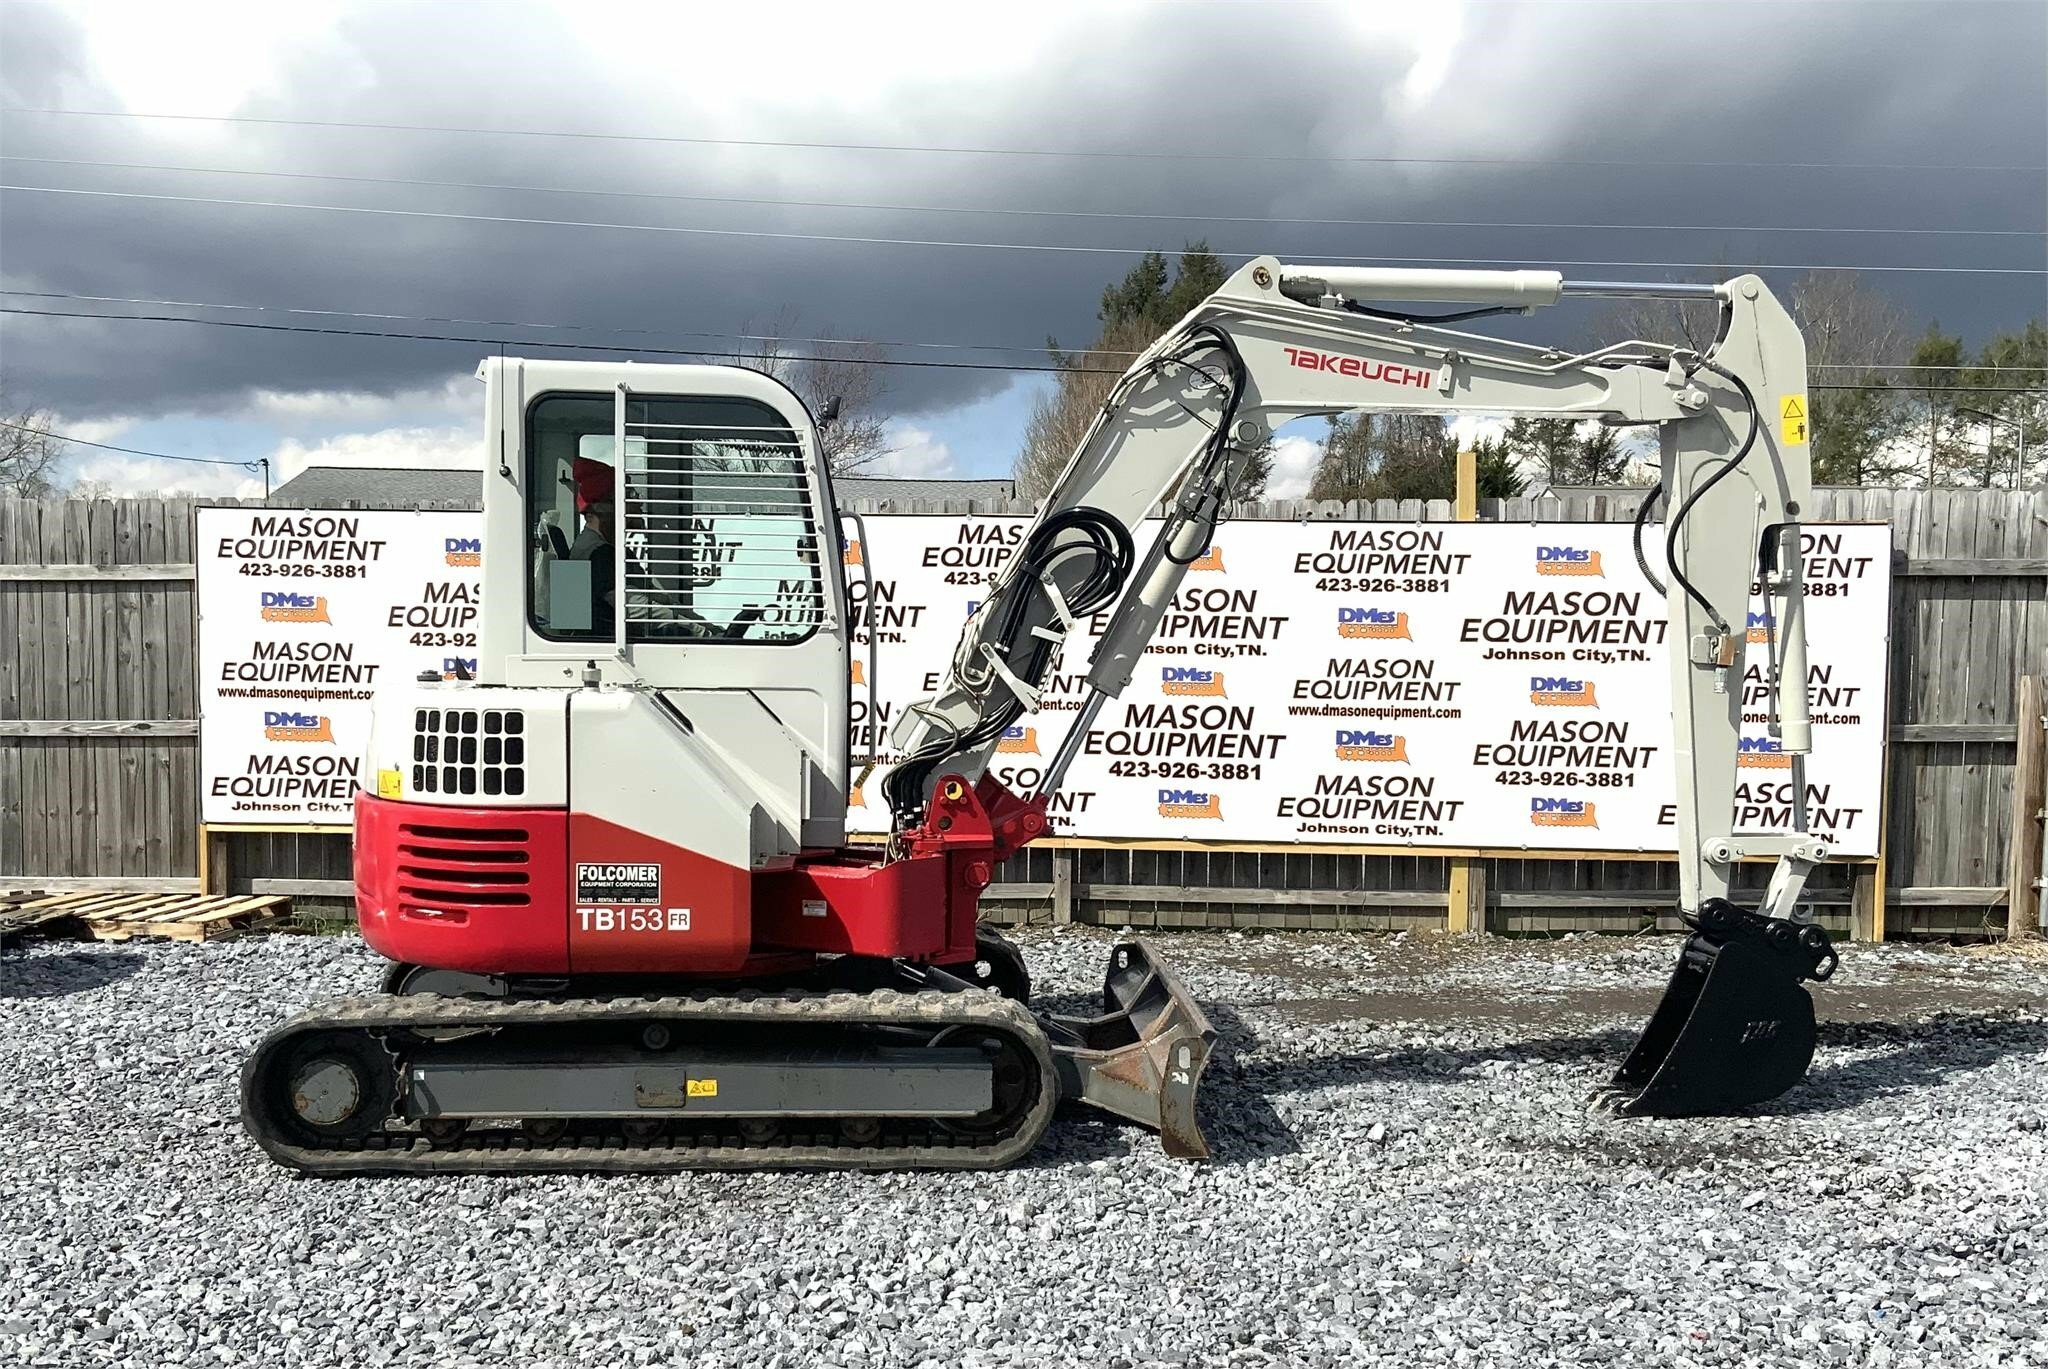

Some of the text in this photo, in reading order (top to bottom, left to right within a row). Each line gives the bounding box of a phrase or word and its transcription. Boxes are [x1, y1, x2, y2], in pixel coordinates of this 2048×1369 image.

[250, 516, 359, 538] MASON
[957, 524, 1024, 545] MAS
[217, 538, 386, 562] EQUIPMENT
[1329, 530, 1444, 552] MASON
[922, 546, 1012, 568] EQUIP
[1293, 552, 1471, 575] EQUIPMENT
[238, 563, 367, 578] 423-926-3881
[1315, 578, 1450, 593] 423-926-3881
[1168, 588, 1258, 613] ASON
[1503, 591, 1640, 616] MASON
[388, 606, 477, 628] EQUIP
[409, 632, 477, 647] 423-92
[1460, 618, 1668, 645] EQUIPMENT
[252, 641, 353, 662] MASON
[1144, 644, 1188, 655] nson
[1482, 648, 1565, 661] Johnson
[221, 662, 380, 684] EQUIPMENT
[1326, 658, 1434, 679] MASON
[217, 686, 375, 702] www.dmasonequipment.co
[1292, 679, 1461, 702] EQUIPMENT
[1124, 704, 1255, 731] MASON
[1288, 704, 1462, 720] www.dmasonequipment.com
[1510, 720, 1629, 743] MASON
[1084, 730, 1287, 760] EQUIPMENT
[247, 755, 360, 777] MASON
[1473, 744, 1658, 769] EQUIPMENT
[1108, 761, 1261, 780] 423-926-3881
[1495, 771, 1635, 787] 423-926-3881
[1314, 774, 1435, 798] MASON
[1734, 782, 1831, 805] ASON
[231, 801, 301, 812] Johnson
[1276, 797, 1464, 822] EQUIPMENT
[1296, 822, 1369, 834] Johnson
[579, 866, 658, 881] FOLCOMER
[576, 908, 688, 931] TB153 FR
